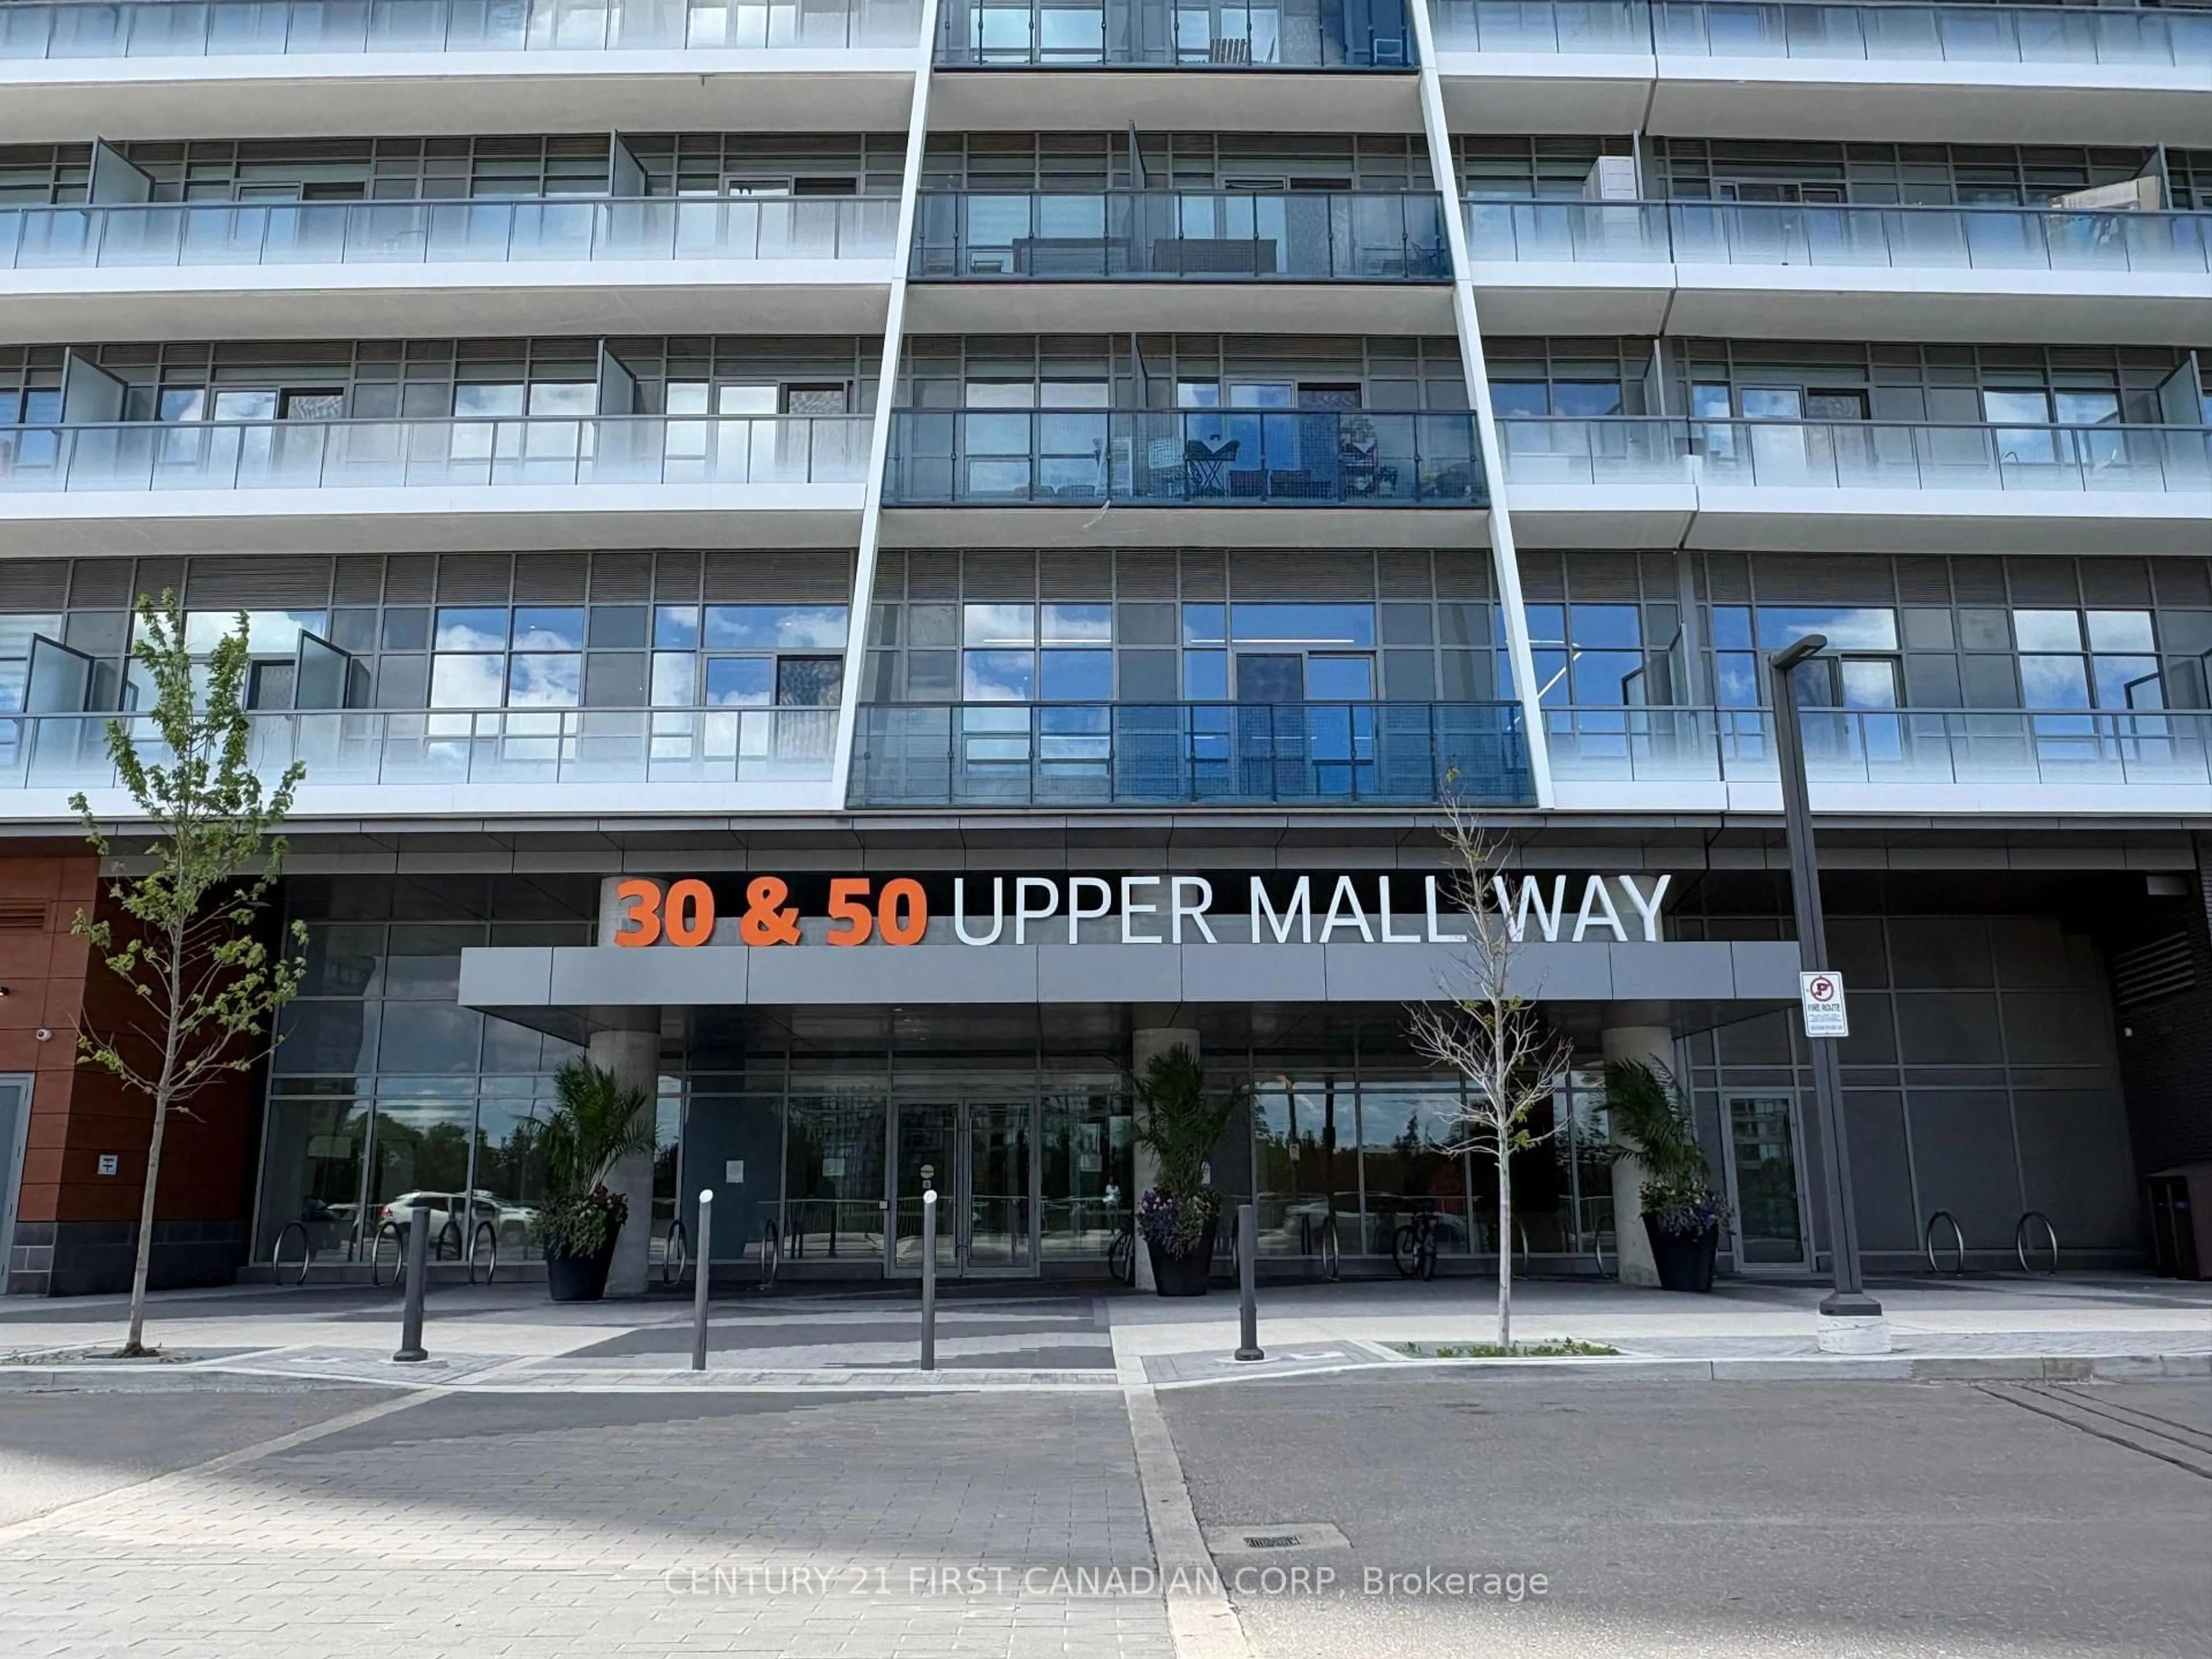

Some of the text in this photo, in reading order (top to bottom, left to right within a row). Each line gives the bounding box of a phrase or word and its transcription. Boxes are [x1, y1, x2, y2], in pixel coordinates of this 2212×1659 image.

[614, 874, 1671, 947] 30 & 50 UPPER MALL WAY
[1808, 1003, 1840, 1012] FIRE ROUTE
